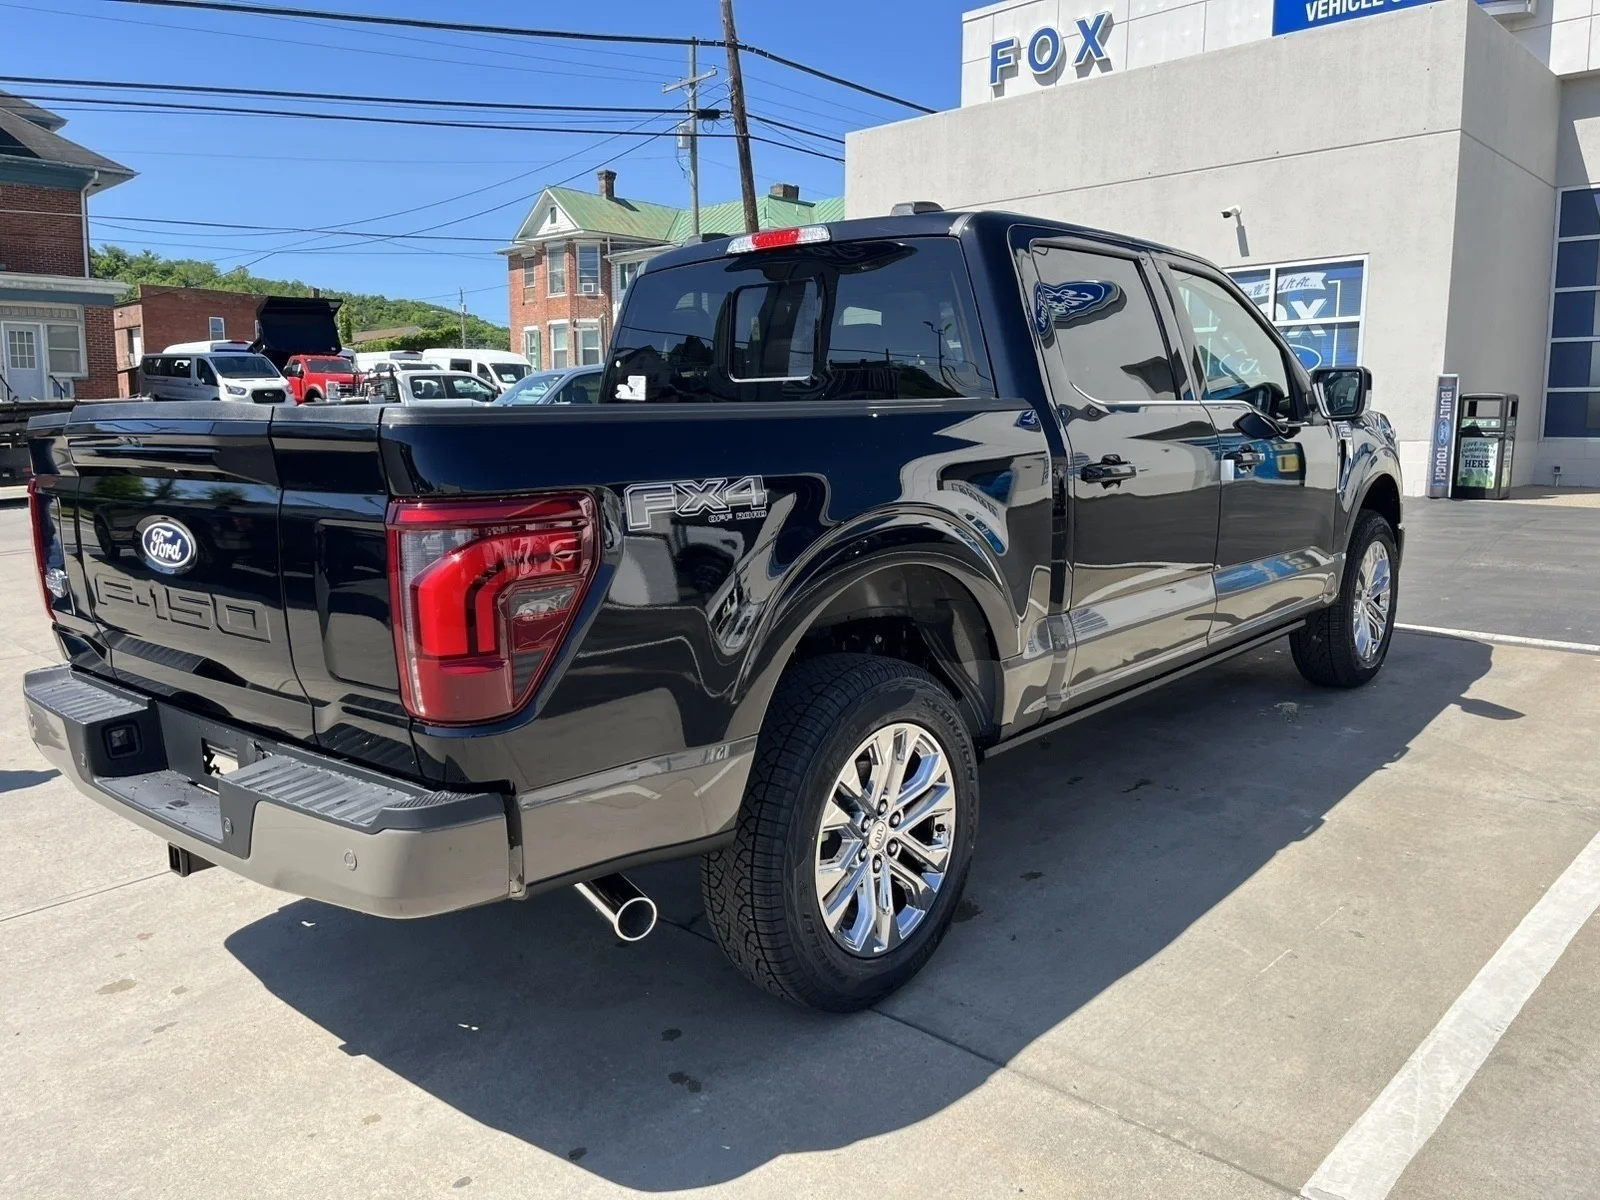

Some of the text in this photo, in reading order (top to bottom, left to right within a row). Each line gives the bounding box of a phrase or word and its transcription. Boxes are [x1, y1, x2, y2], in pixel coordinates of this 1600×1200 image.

[989, 11, 1112, 86] FOX
[1440, 391, 1452, 420] BUILT
[1435, 445, 1448, 480] TOUGH
[1464, 459, 1491, 469] HERE
[624, 475, 767, 531] FX4
[708, 510, 767, 523] OFF ROAD
[150, 527, 183, 561] Ford
[94, 573, 271, 644] F-150
